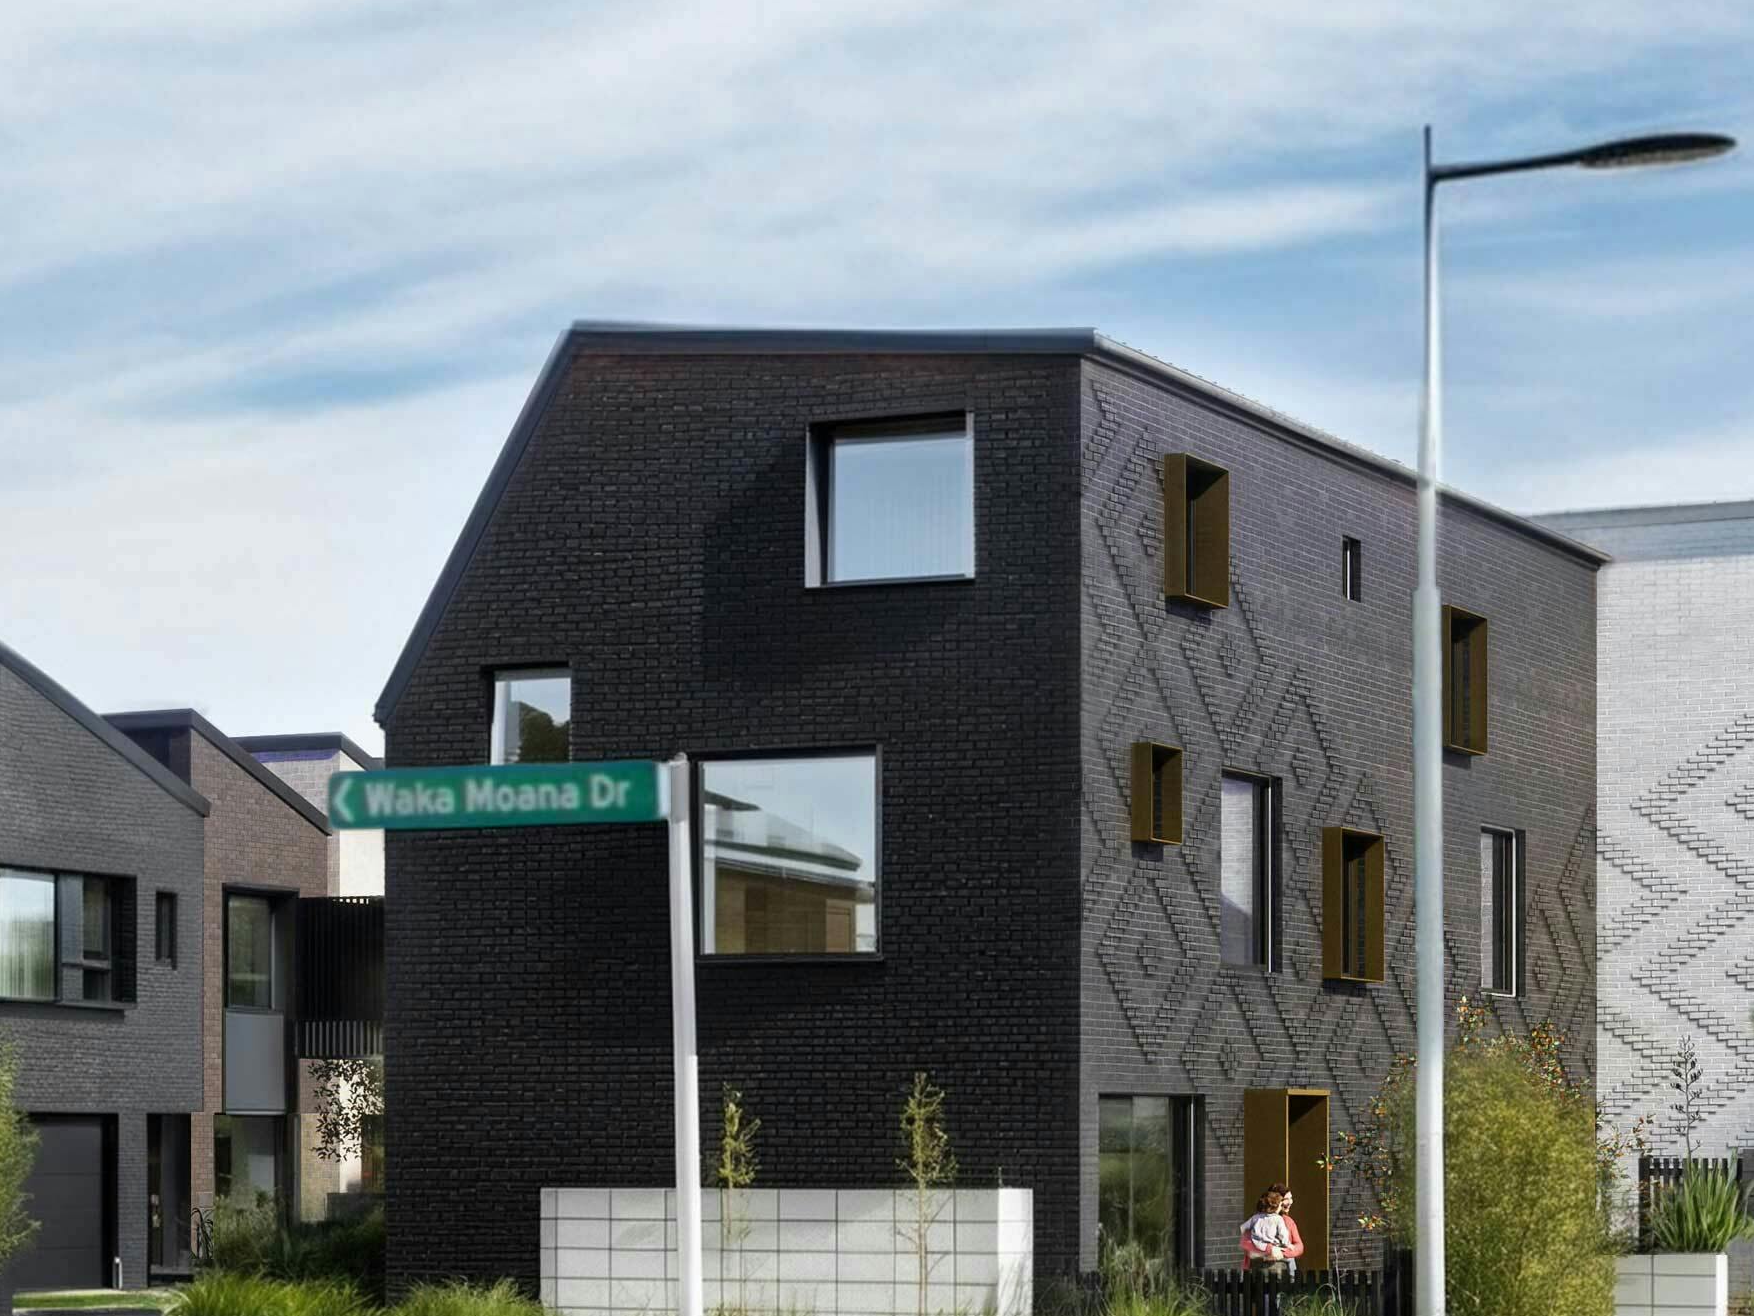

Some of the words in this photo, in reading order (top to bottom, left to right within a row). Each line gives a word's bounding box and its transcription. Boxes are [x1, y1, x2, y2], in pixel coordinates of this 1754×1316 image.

[364, 783, 455, 816] Waka
[466, 779, 579, 812] Moana
[591, 774, 631, 809] Dr
